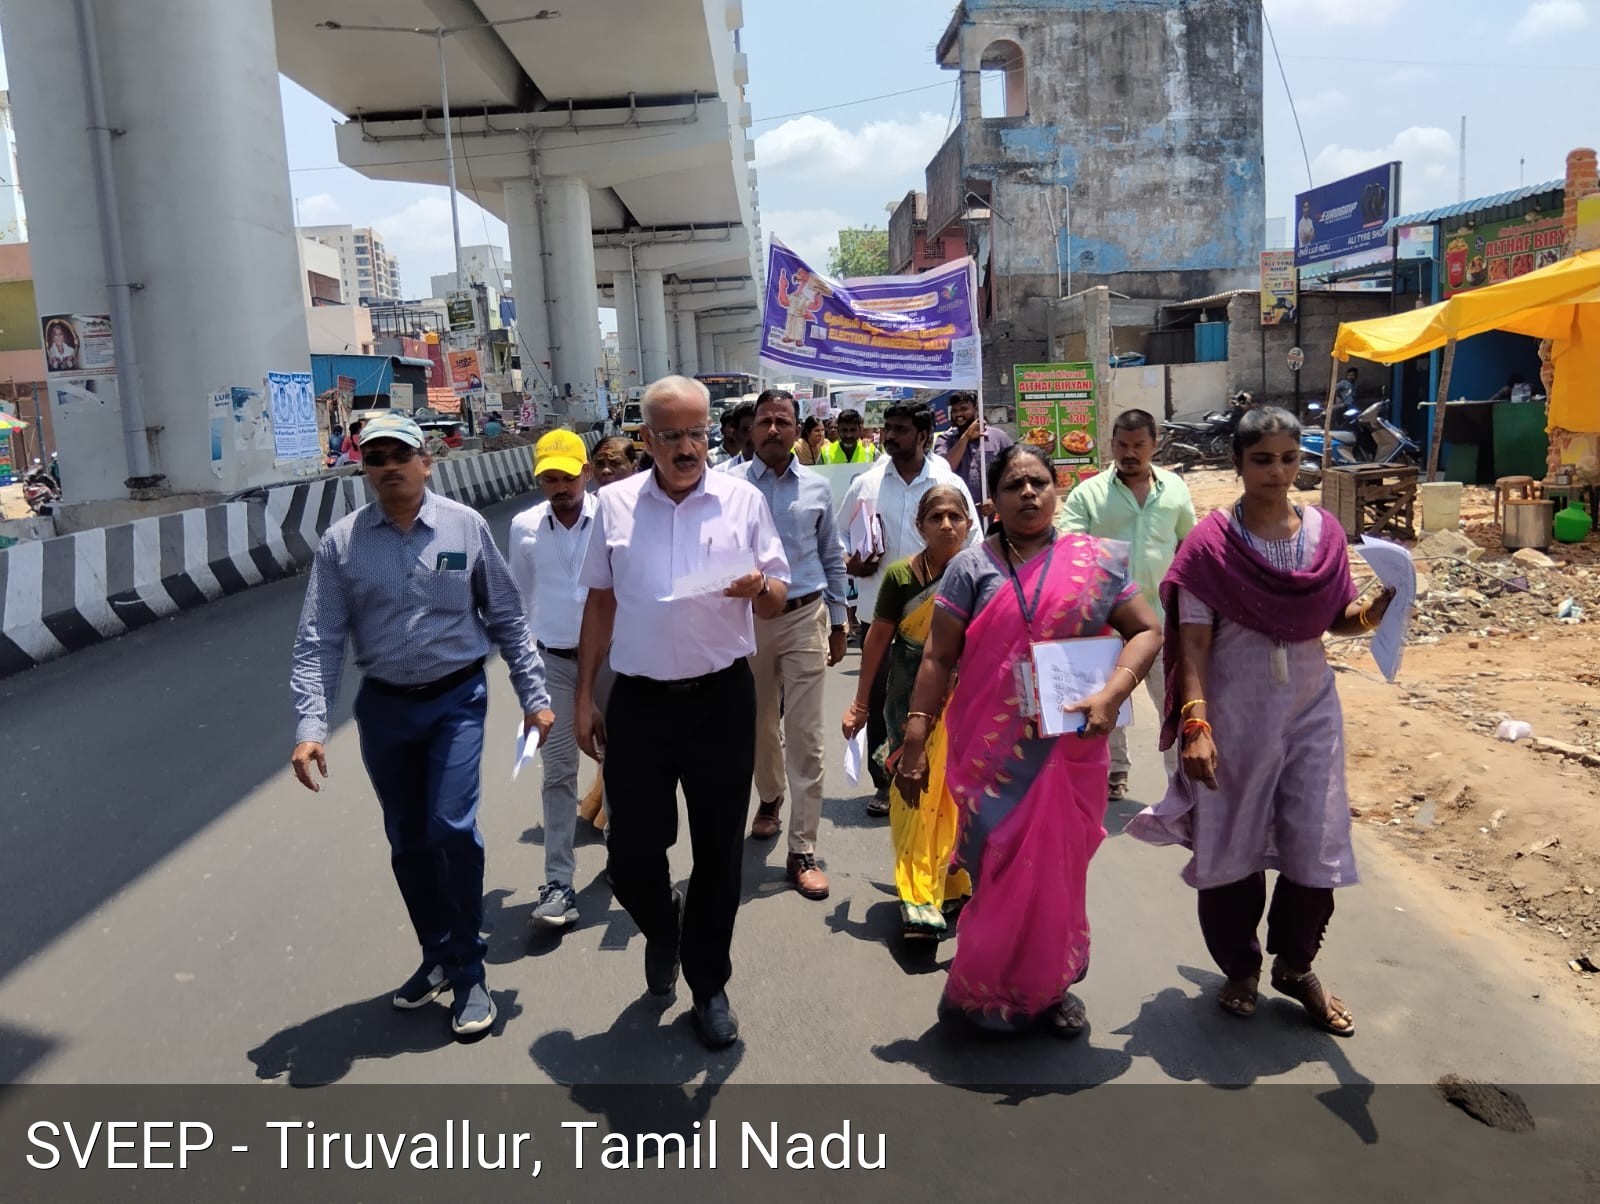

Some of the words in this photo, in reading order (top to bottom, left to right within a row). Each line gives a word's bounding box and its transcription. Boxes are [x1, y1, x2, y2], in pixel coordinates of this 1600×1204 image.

[1319, 202, 1358, 222] EUROGRIP
[1347, 235, 1357, 245] ALI
[1357, 231, 1371, 243] TYRE
[1485, 236, 1530, 257] ALTHAF
[827, 328, 870, 345] ELECTION
[924, 338, 950, 350] RALLY
[1019, 381, 1052, 392] ALTHAF
[1054, 380, 1092, 391] BIRYANI
